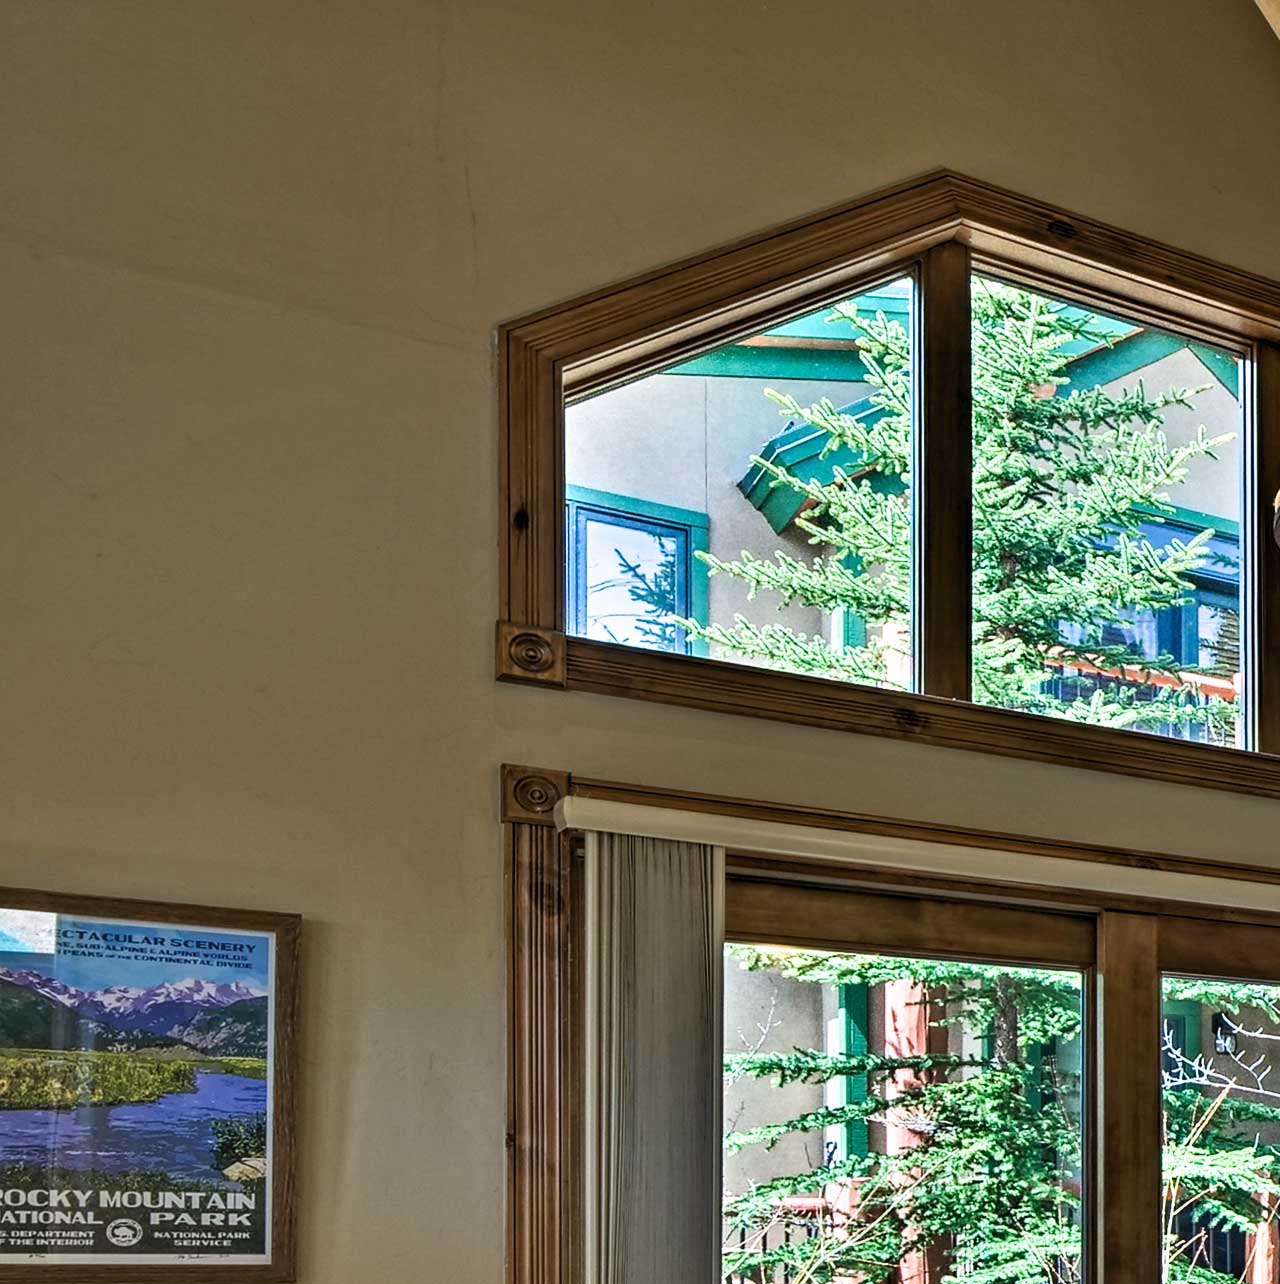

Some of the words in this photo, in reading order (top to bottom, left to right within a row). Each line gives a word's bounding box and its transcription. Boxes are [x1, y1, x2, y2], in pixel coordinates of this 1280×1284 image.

[170, 938, 256, 953] SCENERY
[158, 948, 200, 958] ALPINE
[63, 949, 104, 958] PEAKS
[134, 954, 213, 967] CONTINENTAL
[216, 960, 253, 969] DIVIDE
[0, 1188, 93, 1207] OCKY
[99, 1190, 256, 1209] MOUNTAIN
[150, 1211, 252, 1226] PARK
[11, 1230, 95, 1238] DEPARTMENT
[153, 1231, 216, 1239] NATIONAL
[217, 1231, 251, 1240] PARK
[9, 1238, 34, 1246] THE
[36, 1238, 94, 1246] INTERIOR
[173, 1239, 232, 1247] SERVICE
